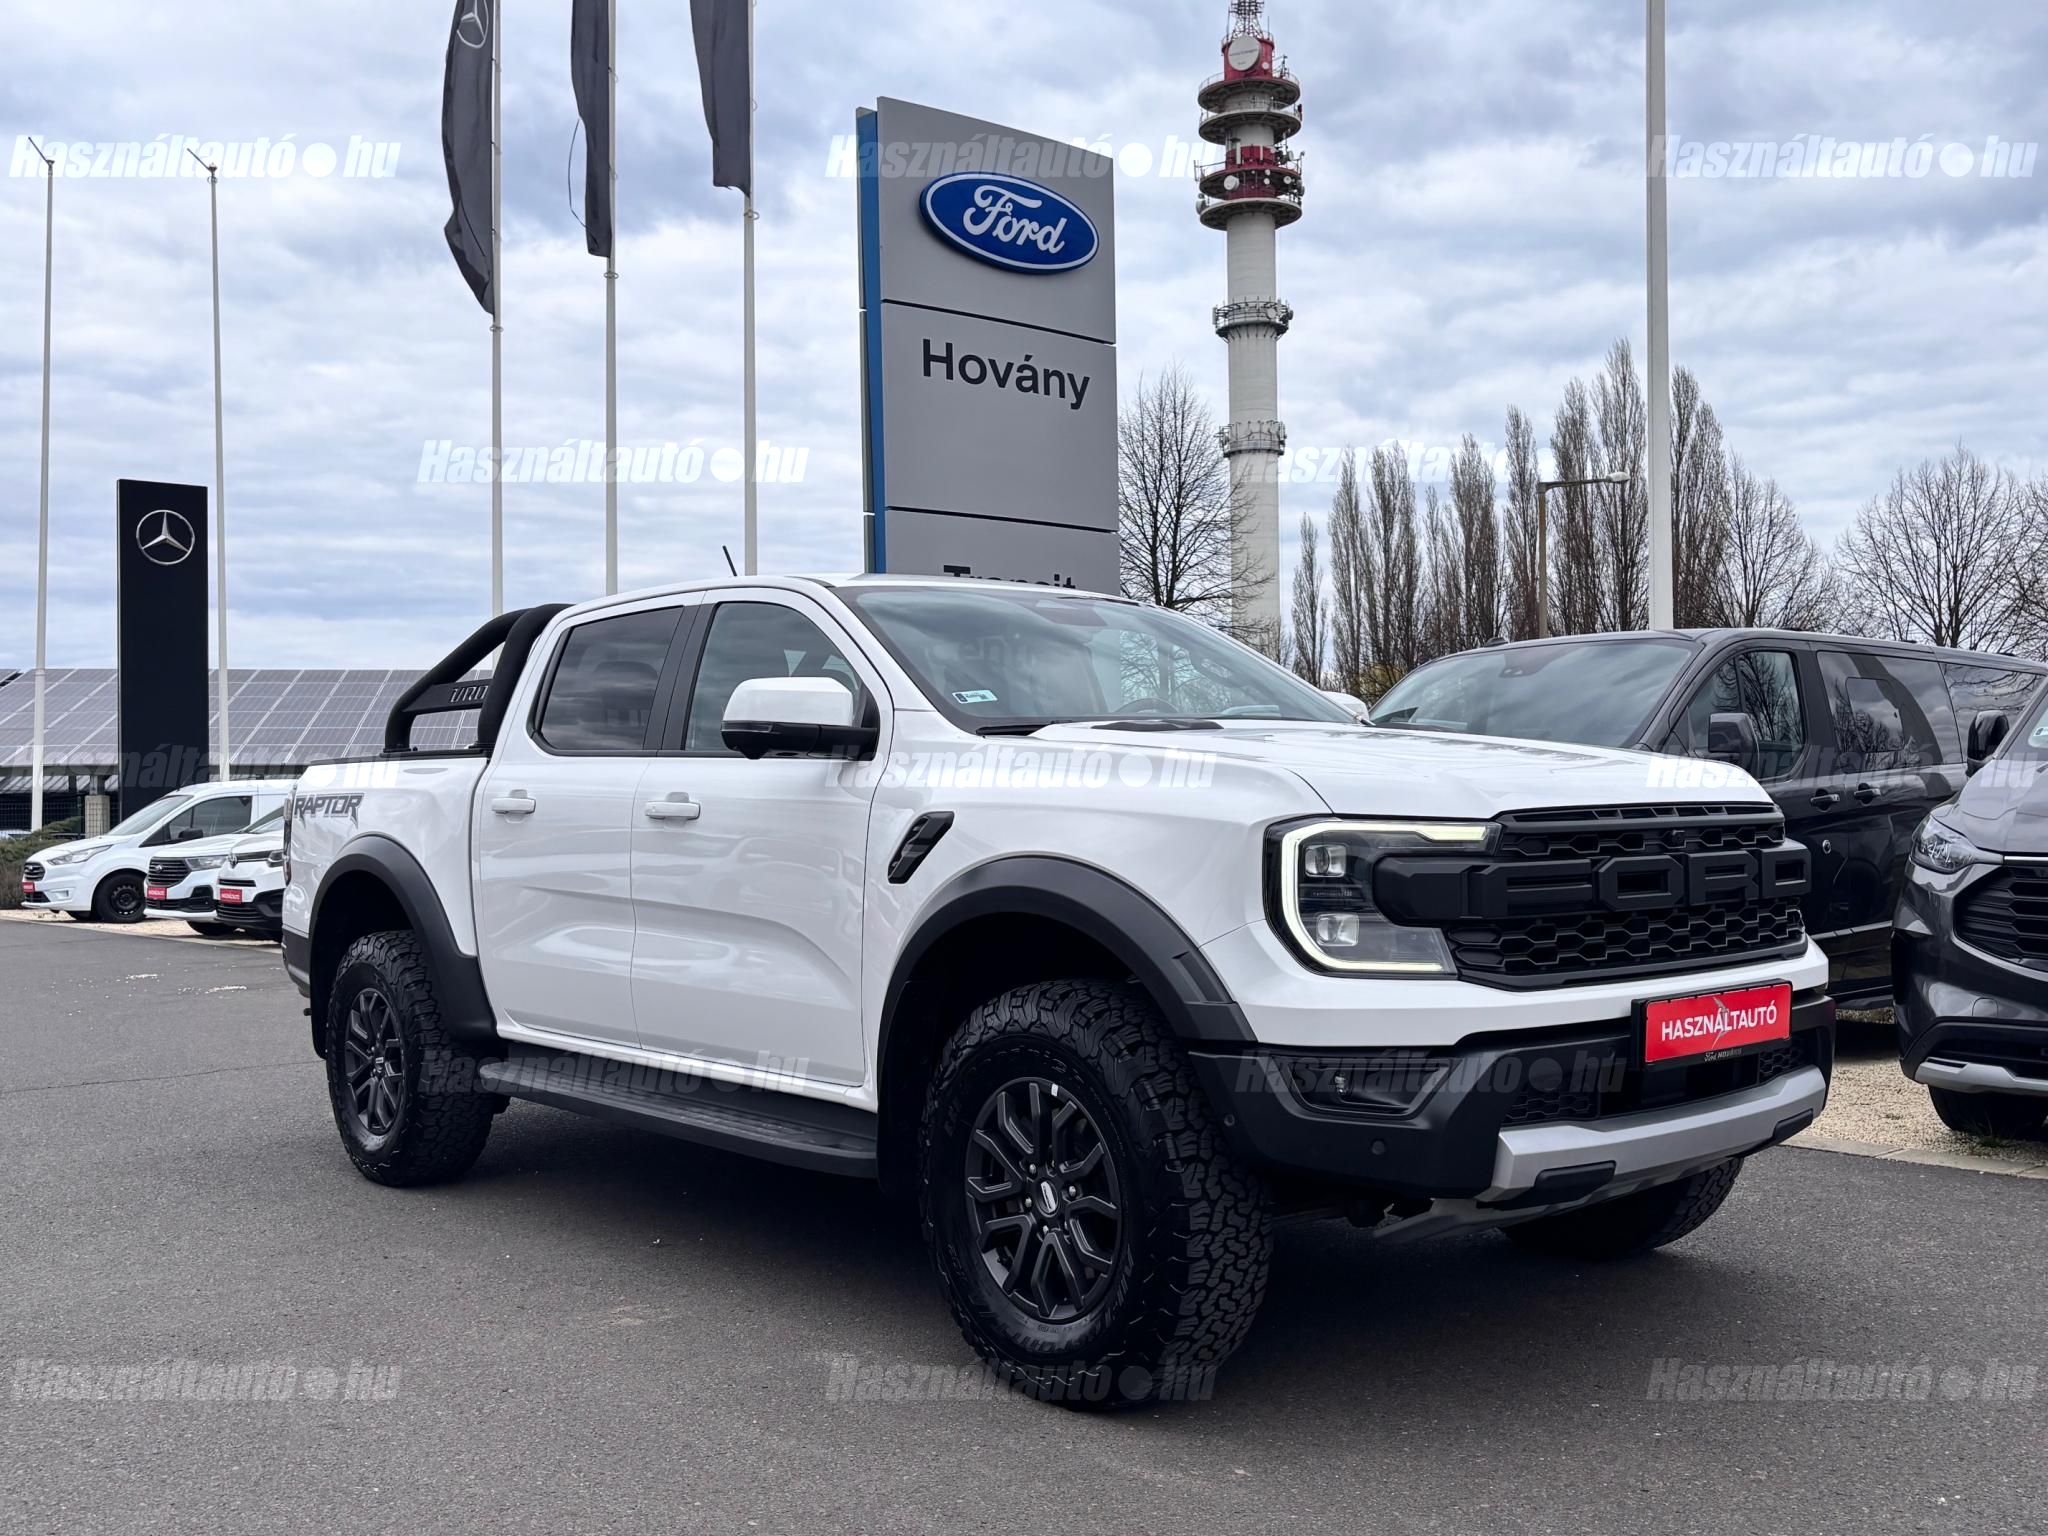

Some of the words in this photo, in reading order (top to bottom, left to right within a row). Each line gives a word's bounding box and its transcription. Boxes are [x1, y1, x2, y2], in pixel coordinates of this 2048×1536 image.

[962, 184, 1068, 254] Ford
[922, 338, 1091, 410] Hovány
[294, 793, 364, 829] RAPTOR
[1484, 847, 1811, 920] FORD
[1662, 1000, 1777, 1042] HASZNÁLTAUTÓ
